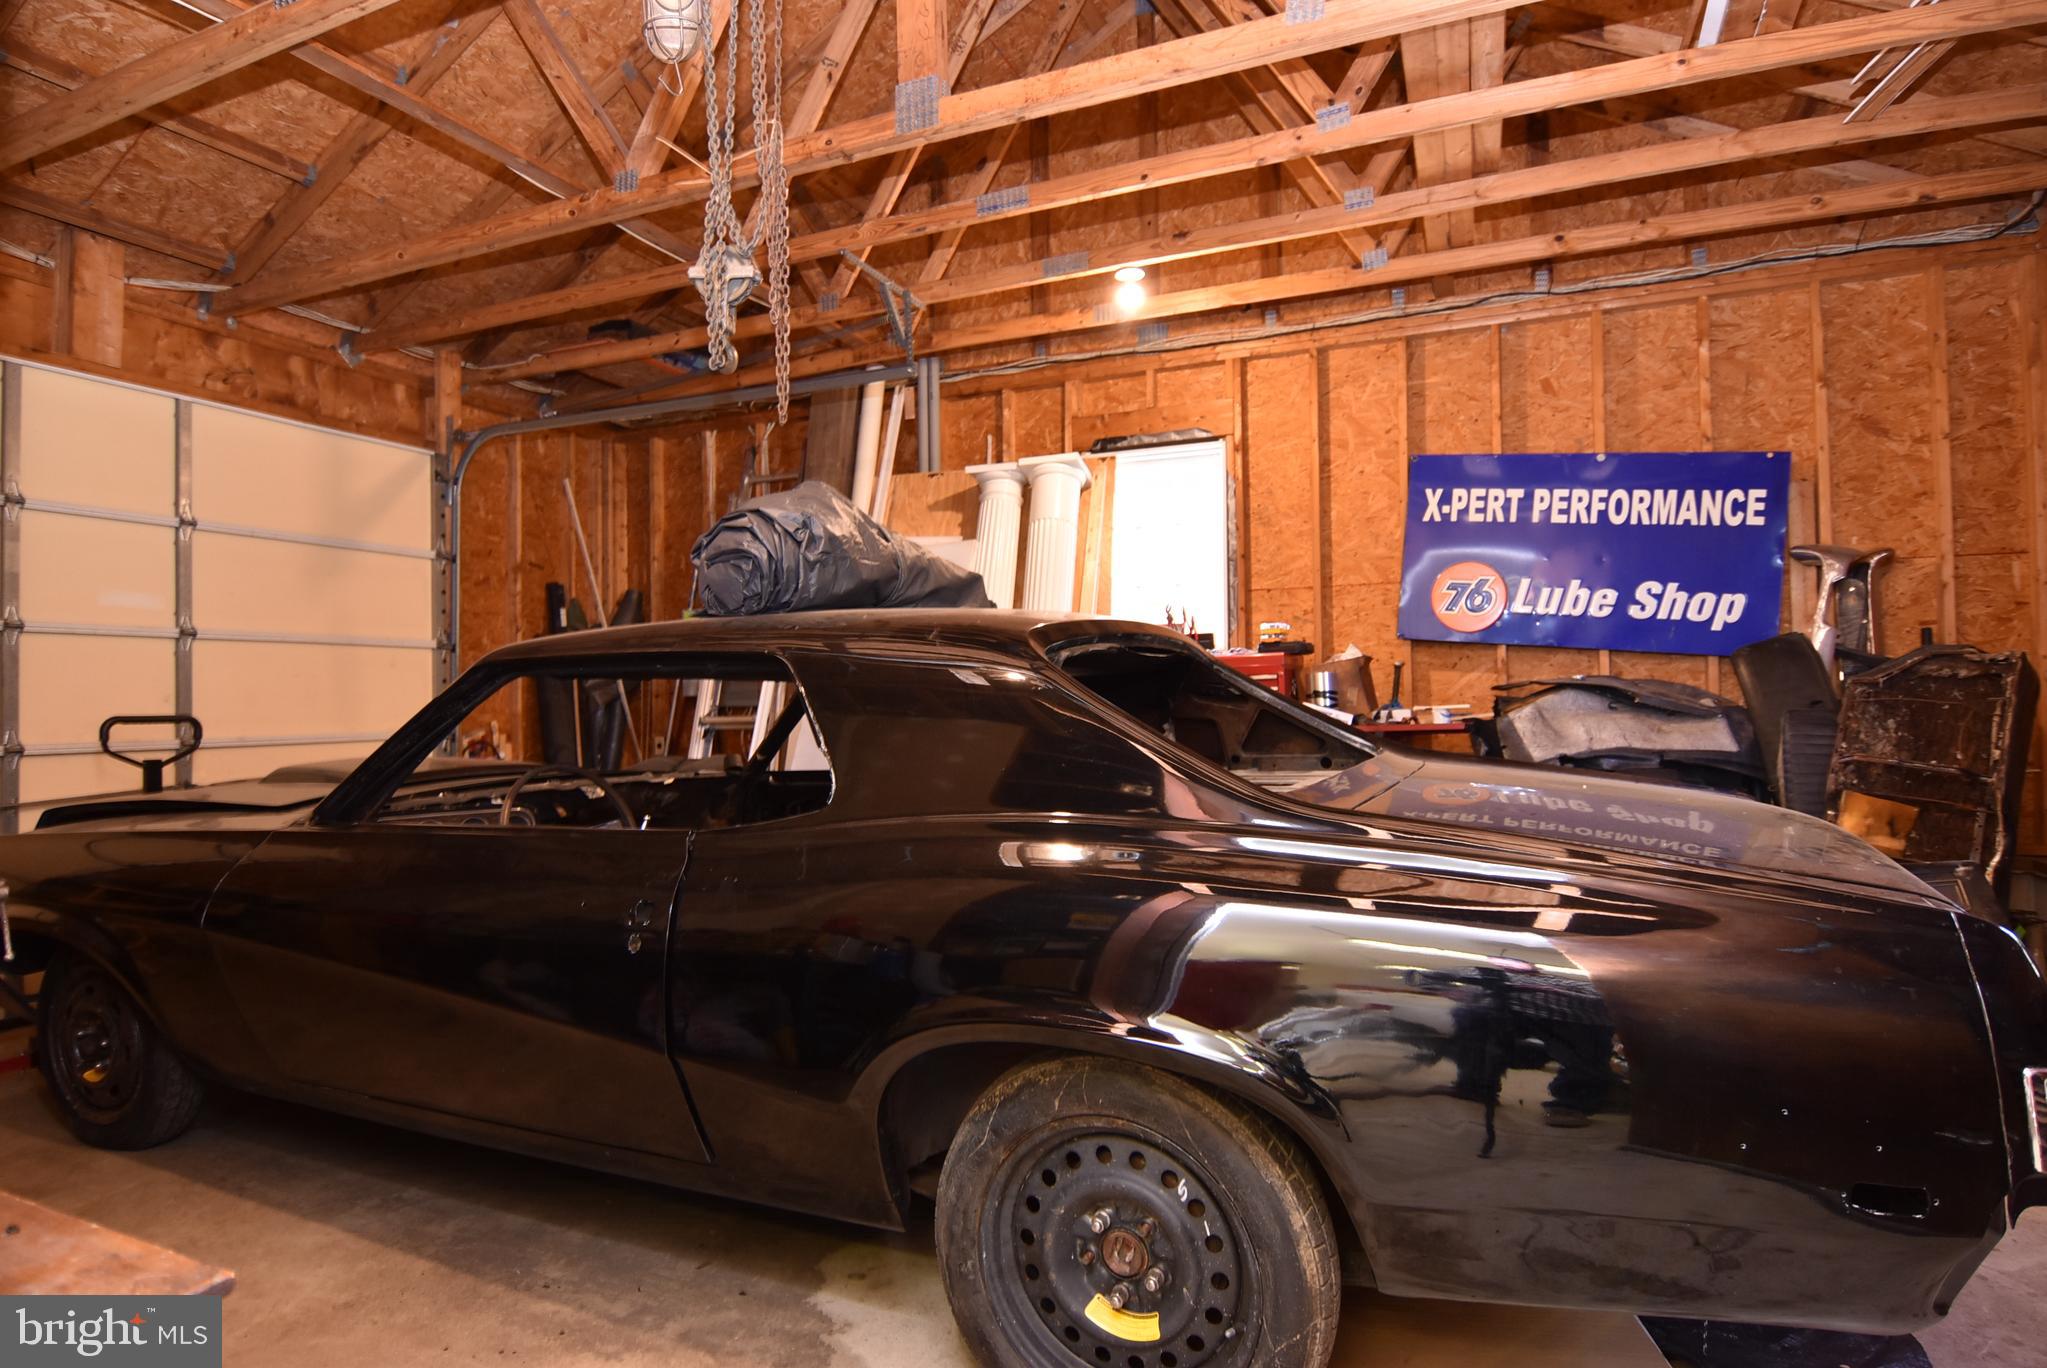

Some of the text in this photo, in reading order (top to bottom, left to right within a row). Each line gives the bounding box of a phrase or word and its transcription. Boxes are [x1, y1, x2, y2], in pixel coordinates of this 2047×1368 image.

[1422, 488, 1768, 526] X-PERT PERFORMANCE
[1440, 576, 1747, 631] 76 Lube Shop
